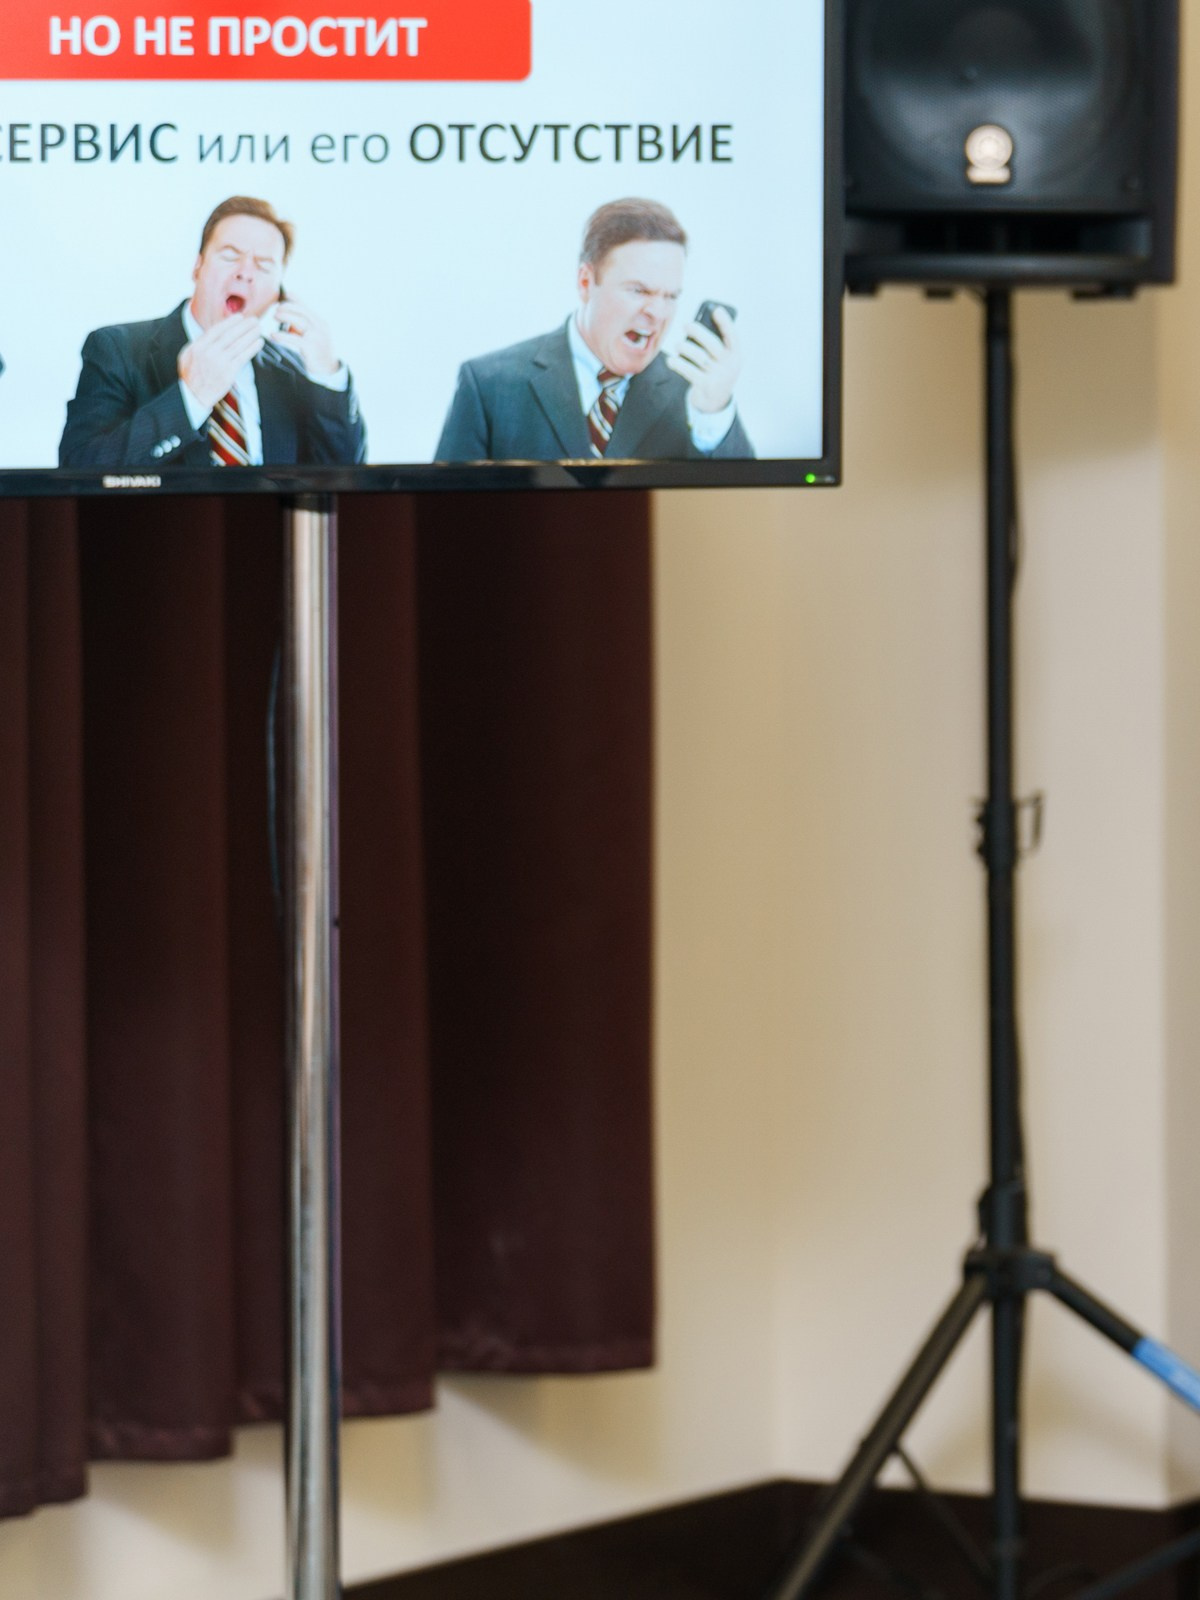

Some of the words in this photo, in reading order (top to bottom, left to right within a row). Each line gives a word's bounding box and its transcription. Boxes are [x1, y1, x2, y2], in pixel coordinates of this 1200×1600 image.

[49, 16, 121, 56] НО
[134, 16, 195, 56] НЕ
[208, 16, 428, 57] ПРОСТИТ
[0, 123, 178, 163] ЕРВИС
[199, 134, 289, 163] или
[310, 134, 390, 163] его
[409, 122, 734, 163] ОТСУТСТВИЕ
